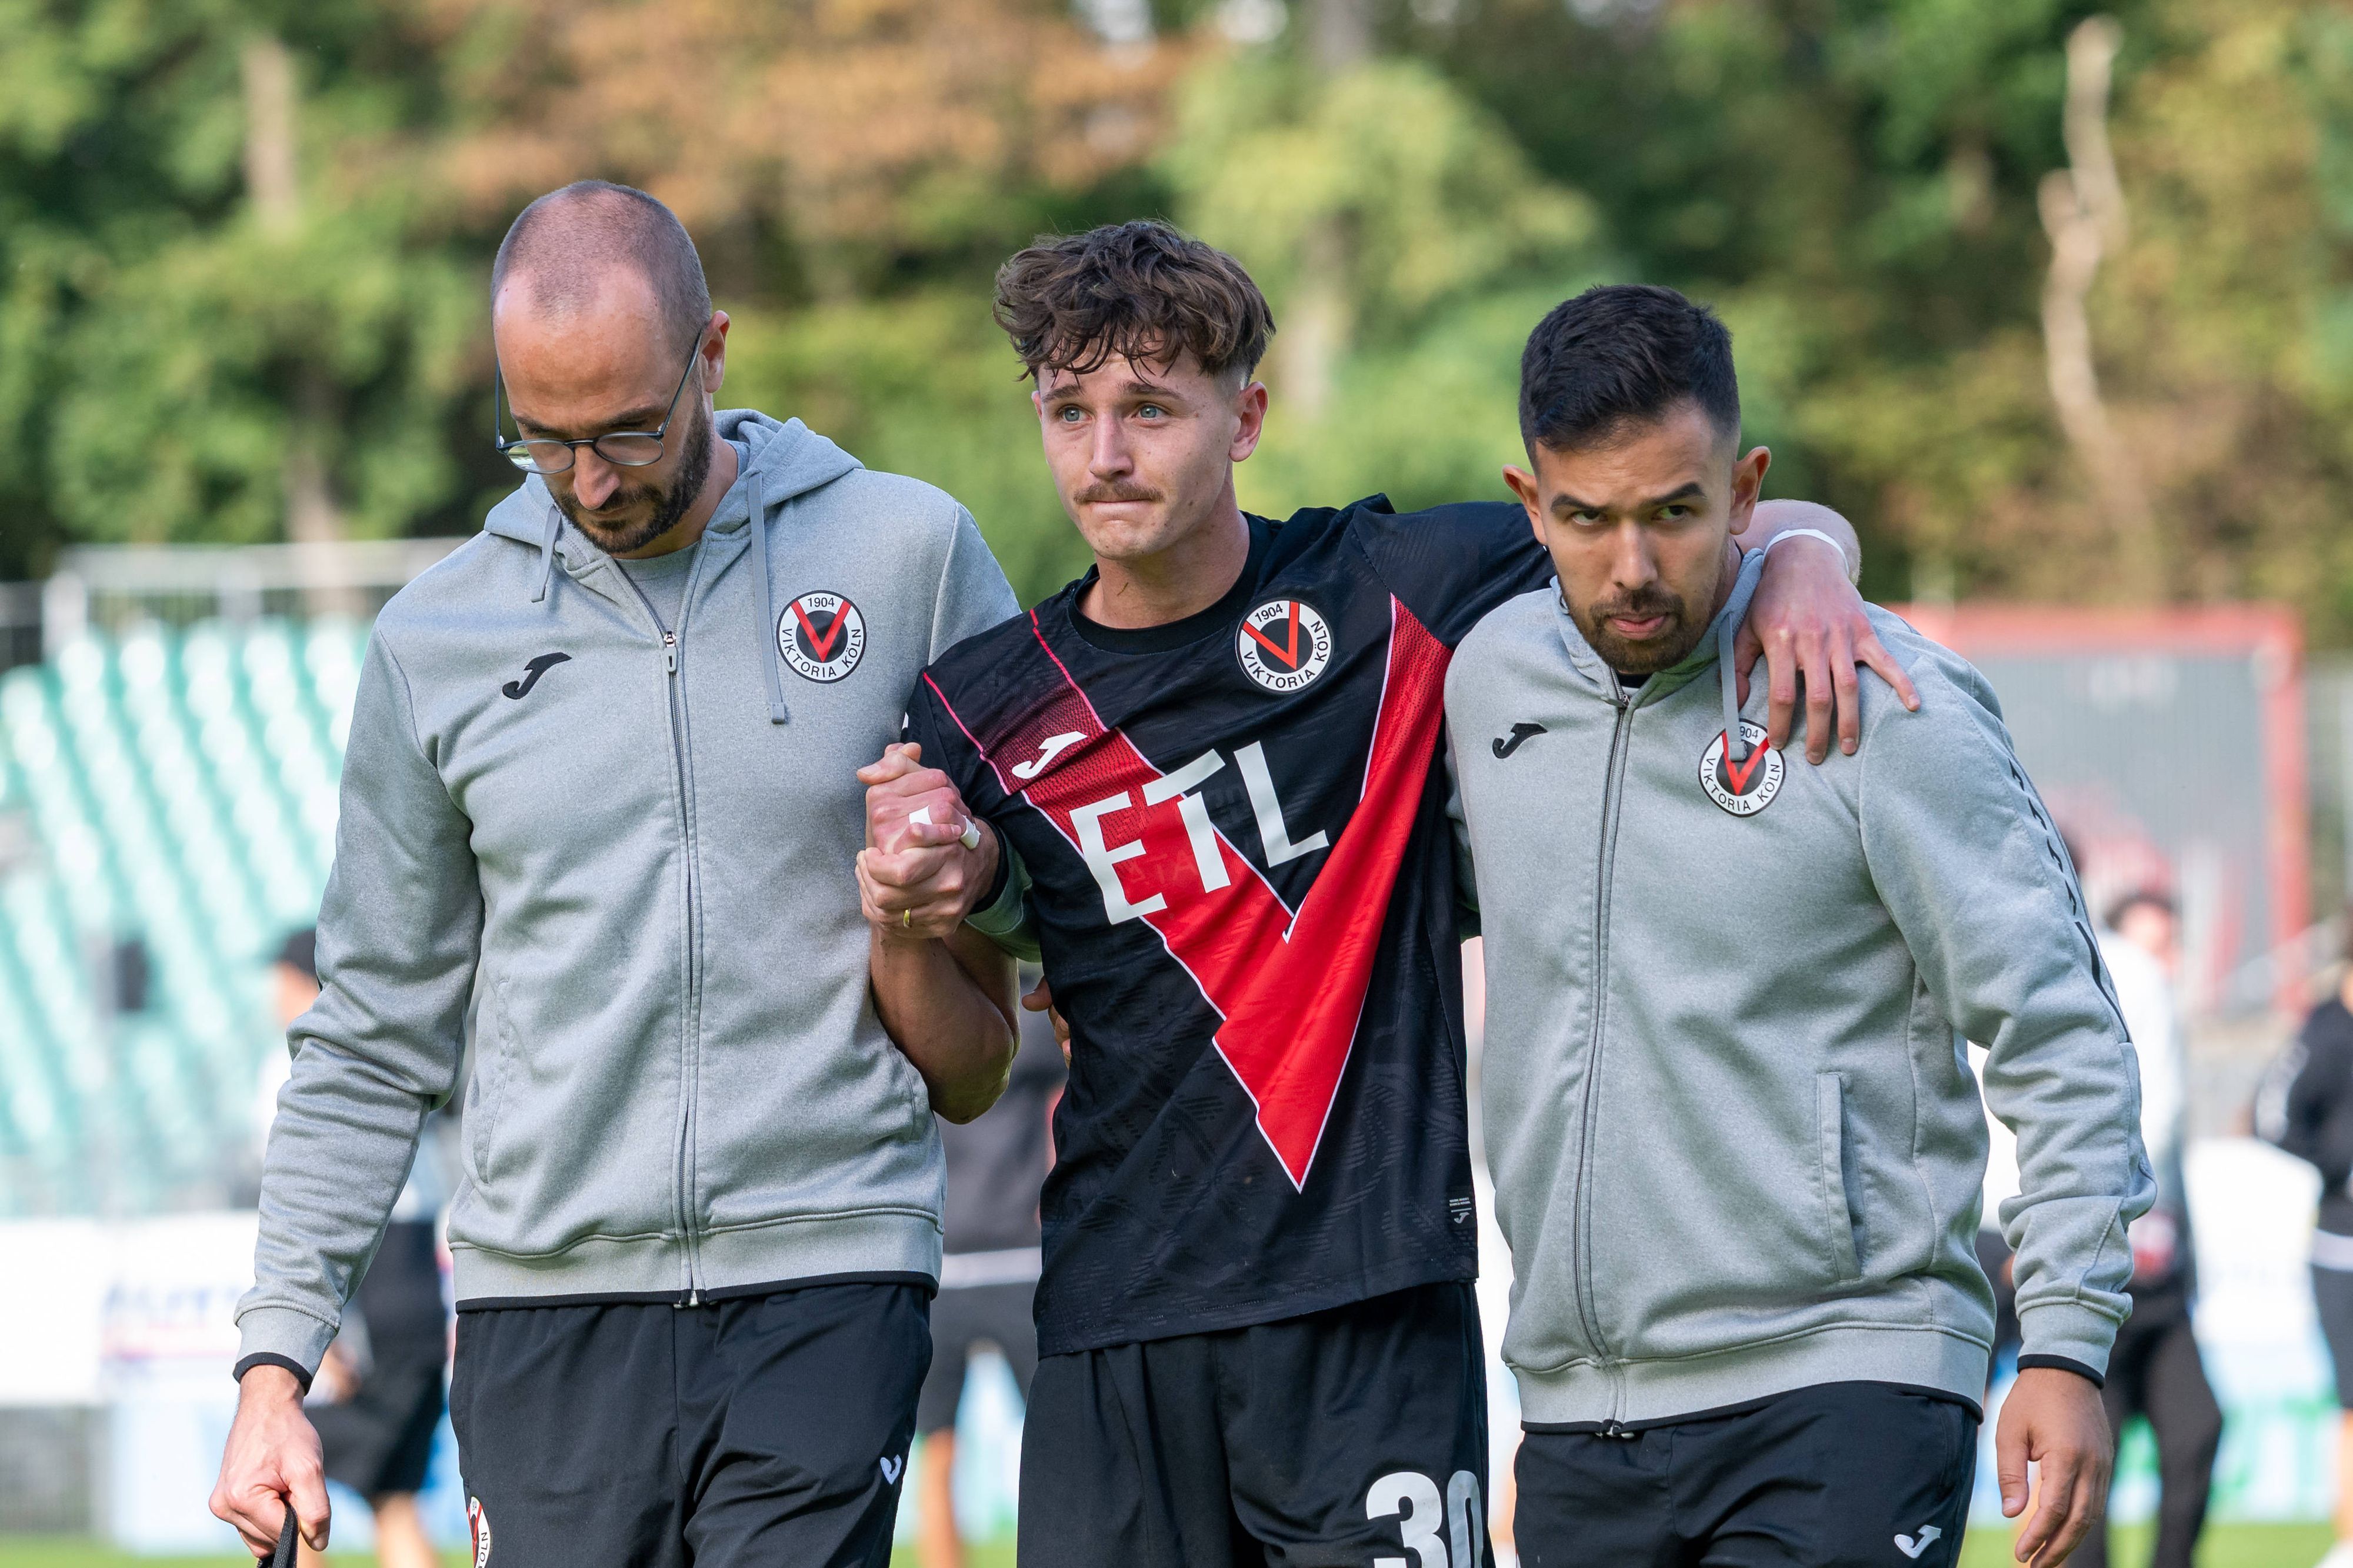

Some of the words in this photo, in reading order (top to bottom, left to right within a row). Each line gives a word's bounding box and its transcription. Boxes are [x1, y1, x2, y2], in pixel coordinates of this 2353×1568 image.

[808, 598, 835, 608] 1904
[1255, 603, 1283, 622] 1904
[782, 628, 836, 678] VIKTORIA
[842, 629, 862, 668] KÖLN
[1244, 651, 1315, 688] VIKTORIA
[1311, 620, 1328, 662] KÖLN
[1739, 726, 1758, 739] 904
[1704, 758, 1751, 811] VIKTORIA
[1757, 764, 1781, 802] KÖLN
[1069, 740, 1329, 925] ETL
[1366, 1470, 1484, 1568] 30
